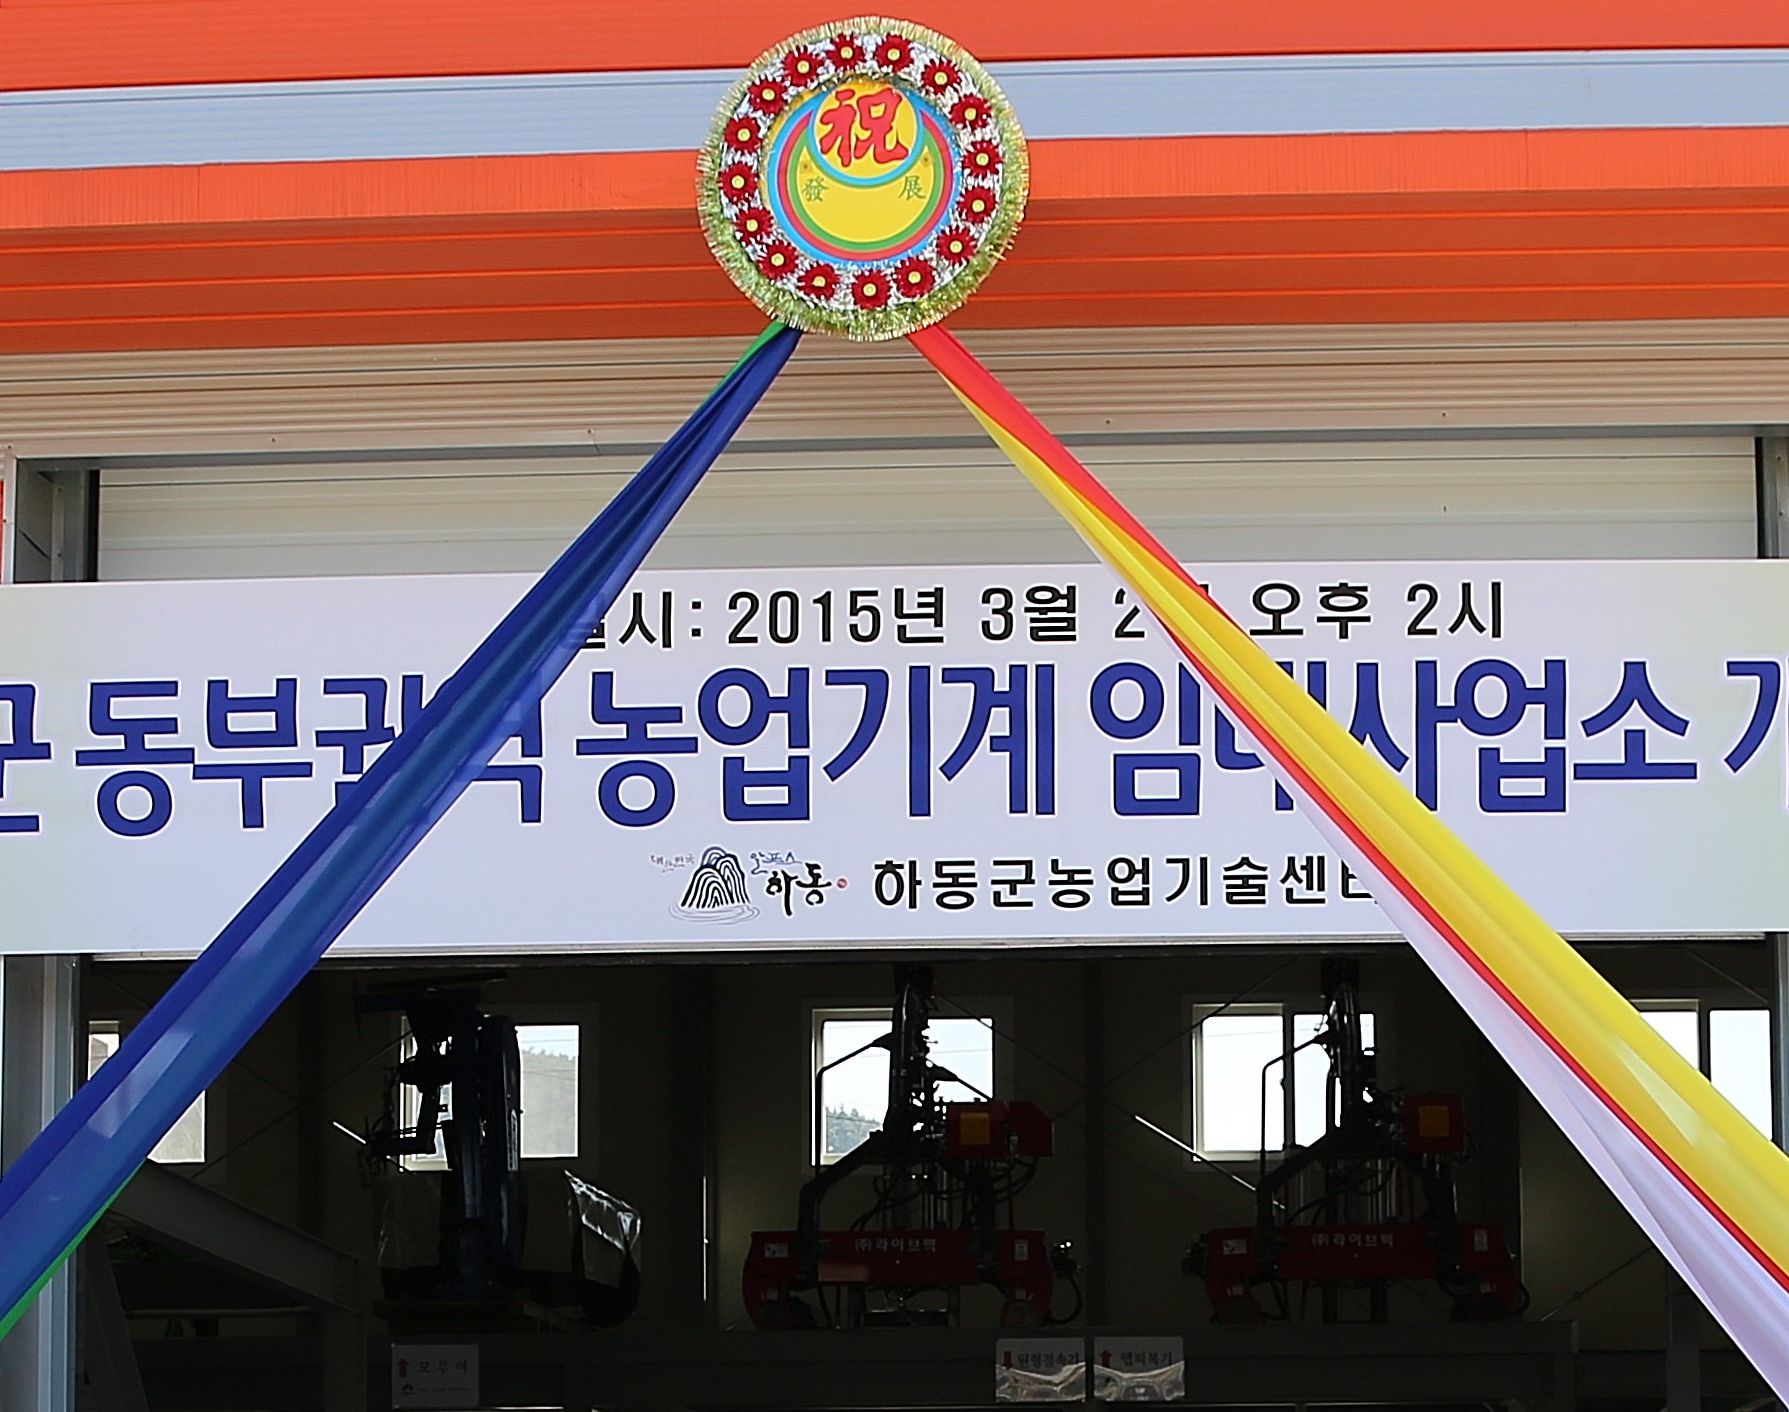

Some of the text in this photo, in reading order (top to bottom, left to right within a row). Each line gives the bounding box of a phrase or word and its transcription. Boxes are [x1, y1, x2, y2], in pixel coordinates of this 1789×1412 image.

[818, 88, 912, 168] 祝
[801, 174, 927, 204] 發 展
[581, 590, 702, 649] 시:
[727, 587, 944, 644] 2015년
[980, 584, 1077, 641] 3월
[1248, 582, 1371, 639] 오후
[1406, 581, 1501, 638] 2시
[575, 664, 1056, 828] 농업기계
[750, 850, 803, 875] 알프스
[765, 861, 833, 917] 하동
